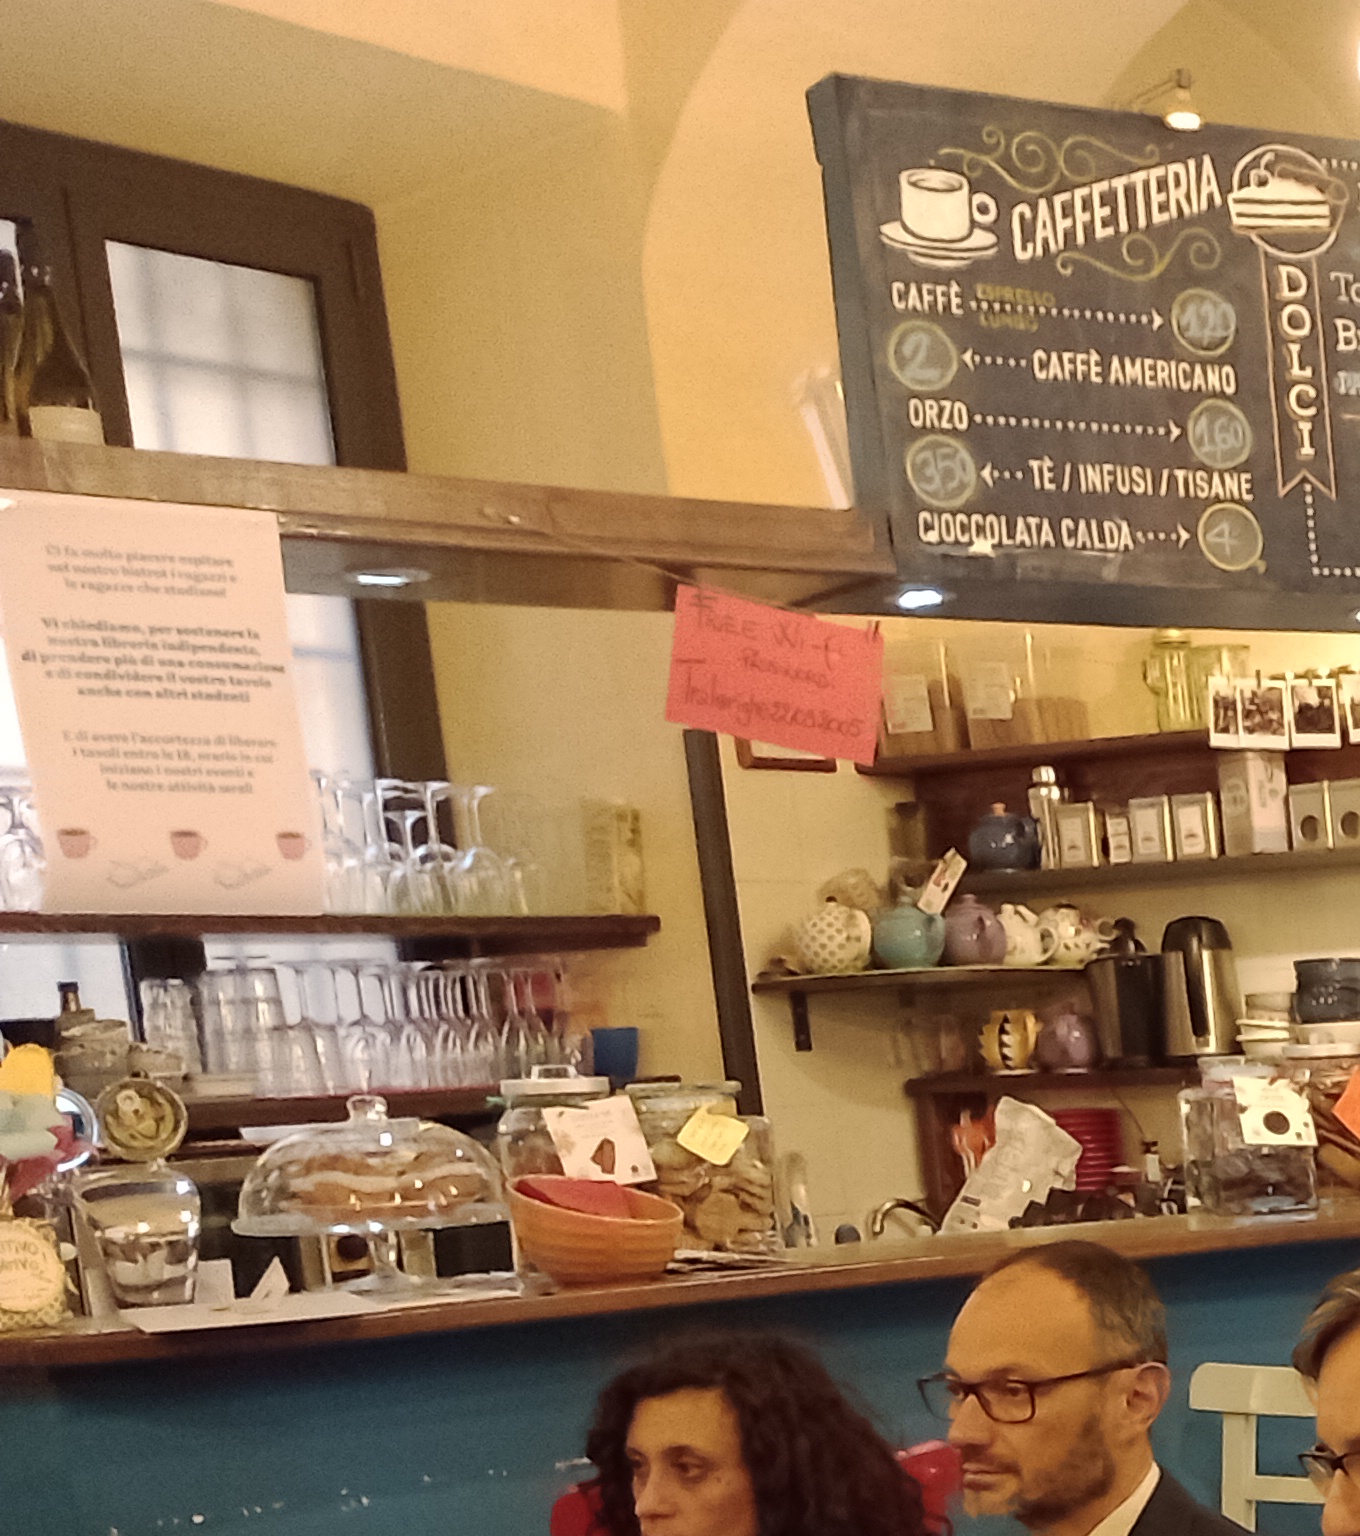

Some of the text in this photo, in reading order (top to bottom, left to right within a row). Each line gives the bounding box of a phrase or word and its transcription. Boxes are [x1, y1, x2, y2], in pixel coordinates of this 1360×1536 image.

[1011, 153, 1223, 263] CAFFETTERIA
[891, 280, 964, 315] CAFFÈ
[1032, 348, 1237, 396] CAFFÈ AMERICANO
[1276, 264, 1317, 460] DOLCI
[908, 398, 969, 431] ORZO
[1028, 455, 1056, 491] TÈ
[1078, 463, 1153, 497] INFUSI
[1173, 468, 1254, 501] TISANE
[918, 510, 1053, 548] CIOCCOLATA
[1060, 518, 1135, 551] CALDA
